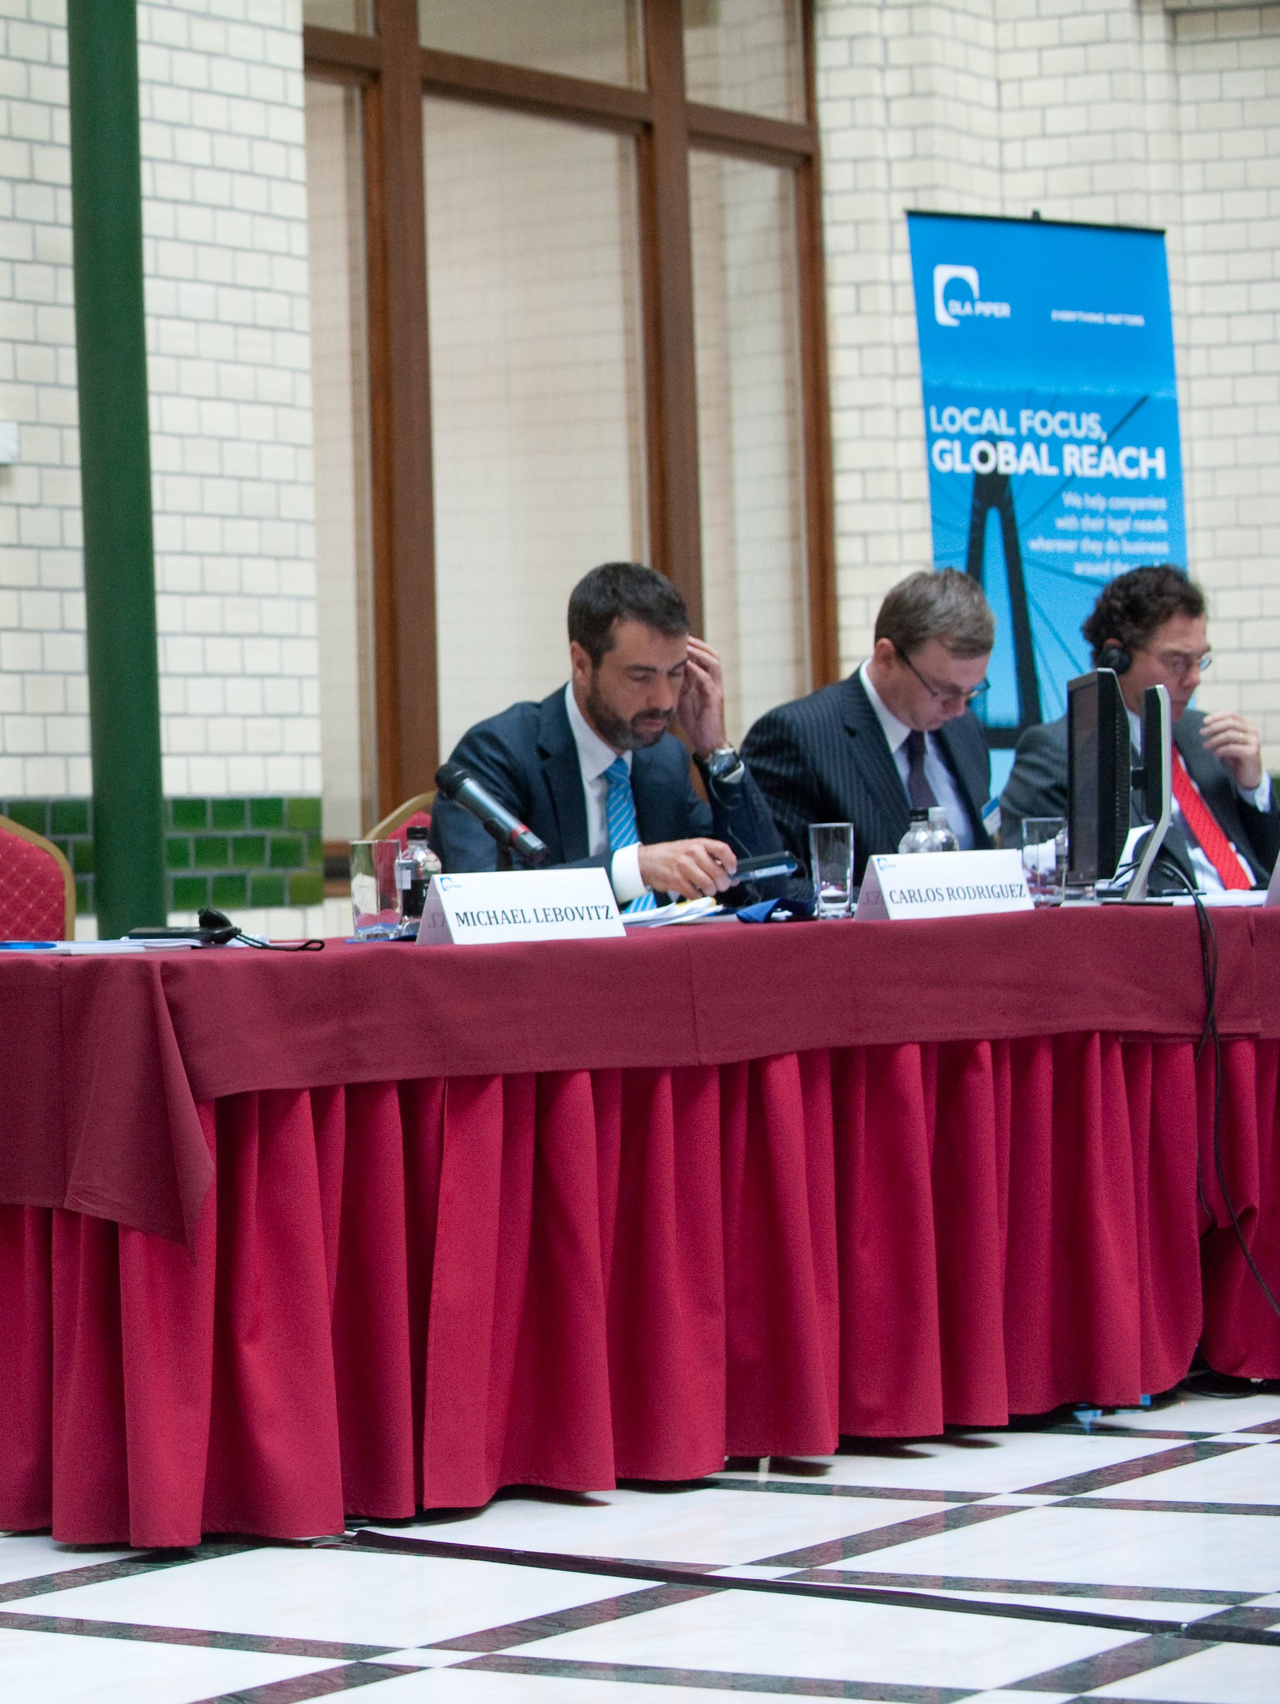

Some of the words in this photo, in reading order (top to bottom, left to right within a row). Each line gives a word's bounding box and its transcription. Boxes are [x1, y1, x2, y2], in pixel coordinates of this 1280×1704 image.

[929, 405, 1016, 436] LOCAL
[1020, 409, 1108, 443] FOCUS,
[931, 438, 1059, 476] GLOBAL
[1062, 444, 1167, 480] REACH
[889, 887, 944, 905] CARLOS
[945, 883, 1027, 902] RODRIGUEZ
[455, 908, 531, 928] MICHAEL
[534, 905, 614, 924] LEBOVITZ
